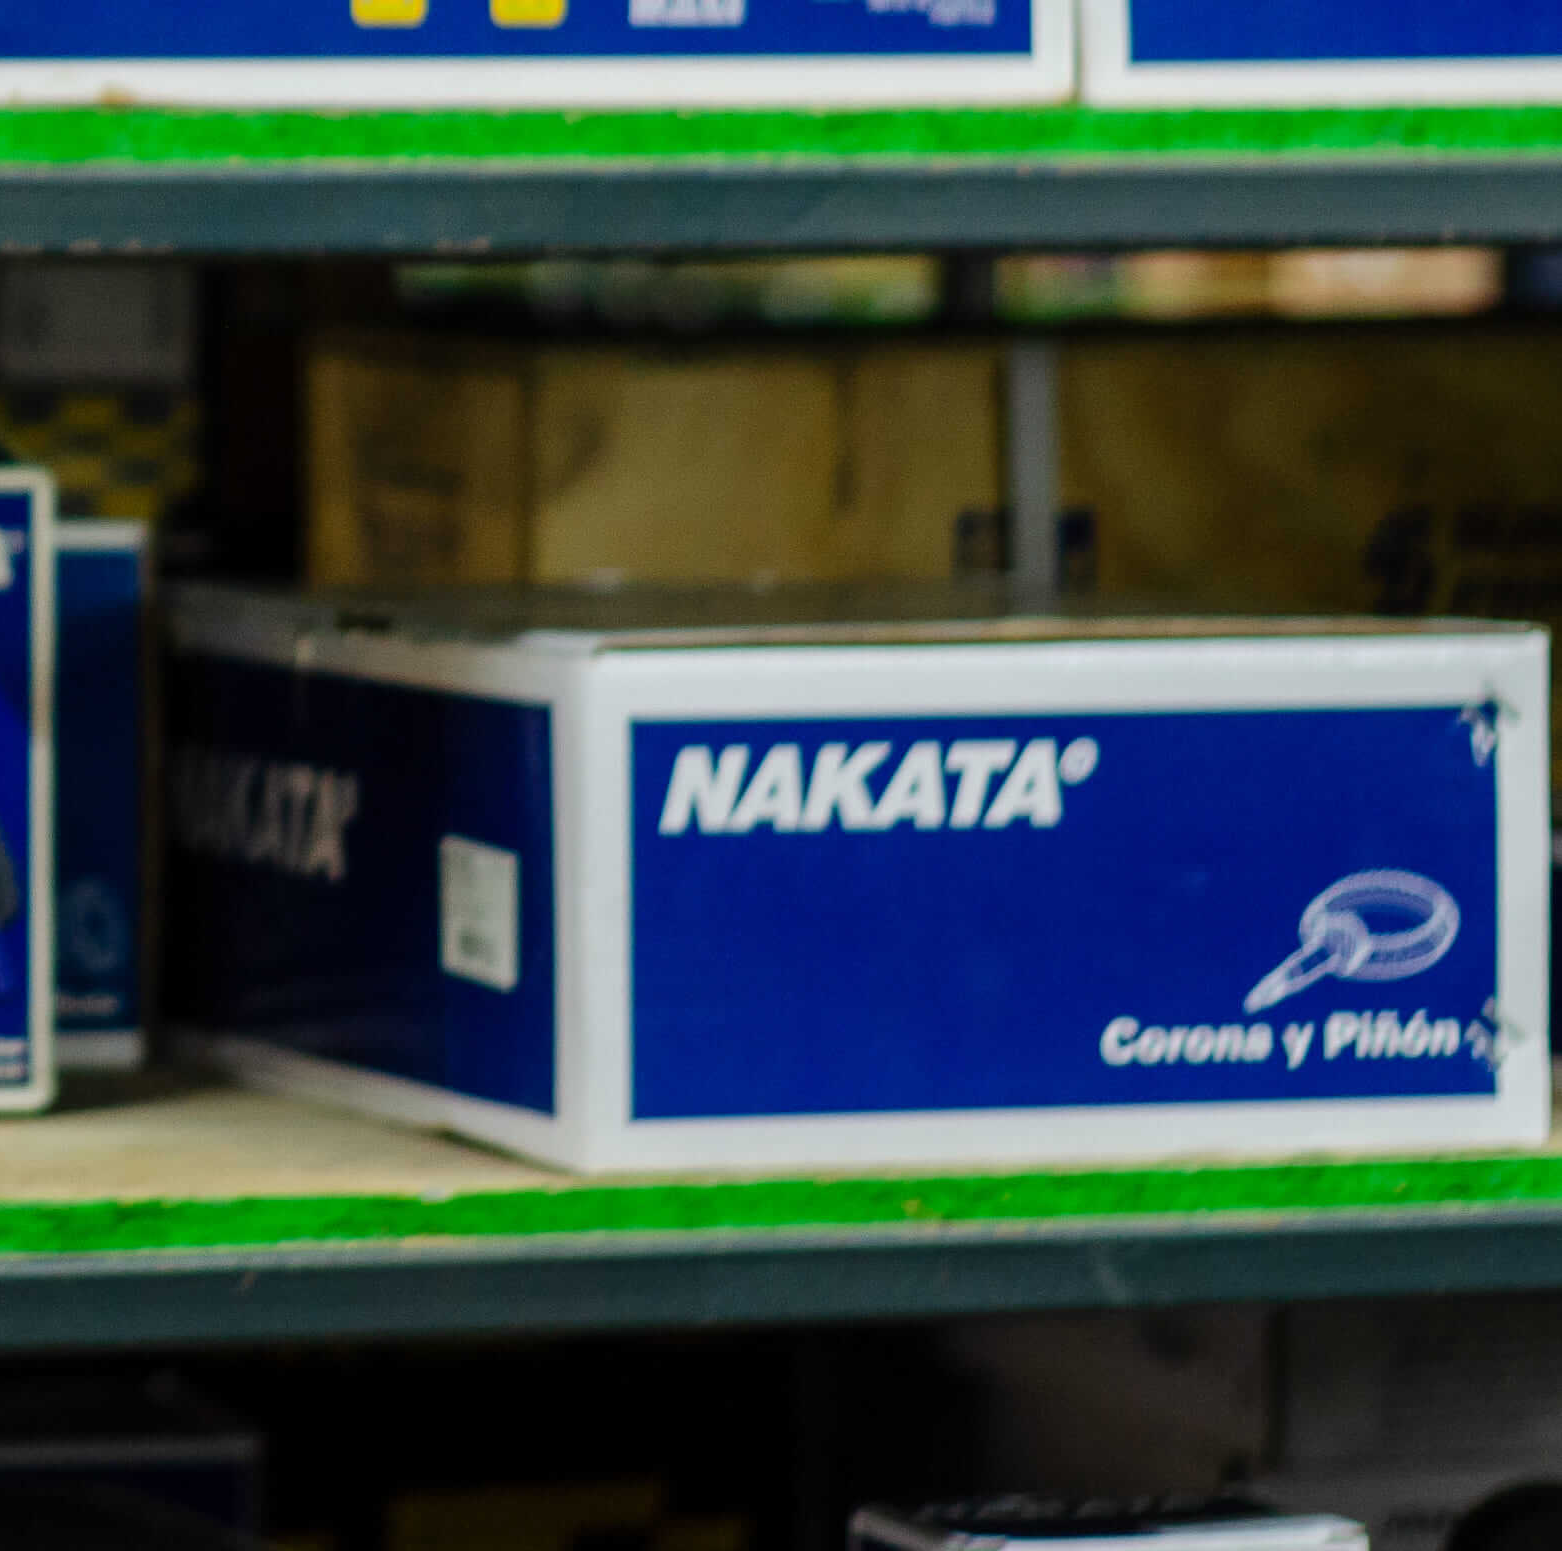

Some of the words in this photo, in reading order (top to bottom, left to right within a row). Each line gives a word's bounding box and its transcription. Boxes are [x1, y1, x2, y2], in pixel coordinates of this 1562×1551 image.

[1099, 1015, 1274, 1067] Corona
[1282, 1022, 1315, 1071] y
[1323, 1008, 1461, 1060] Piñón
